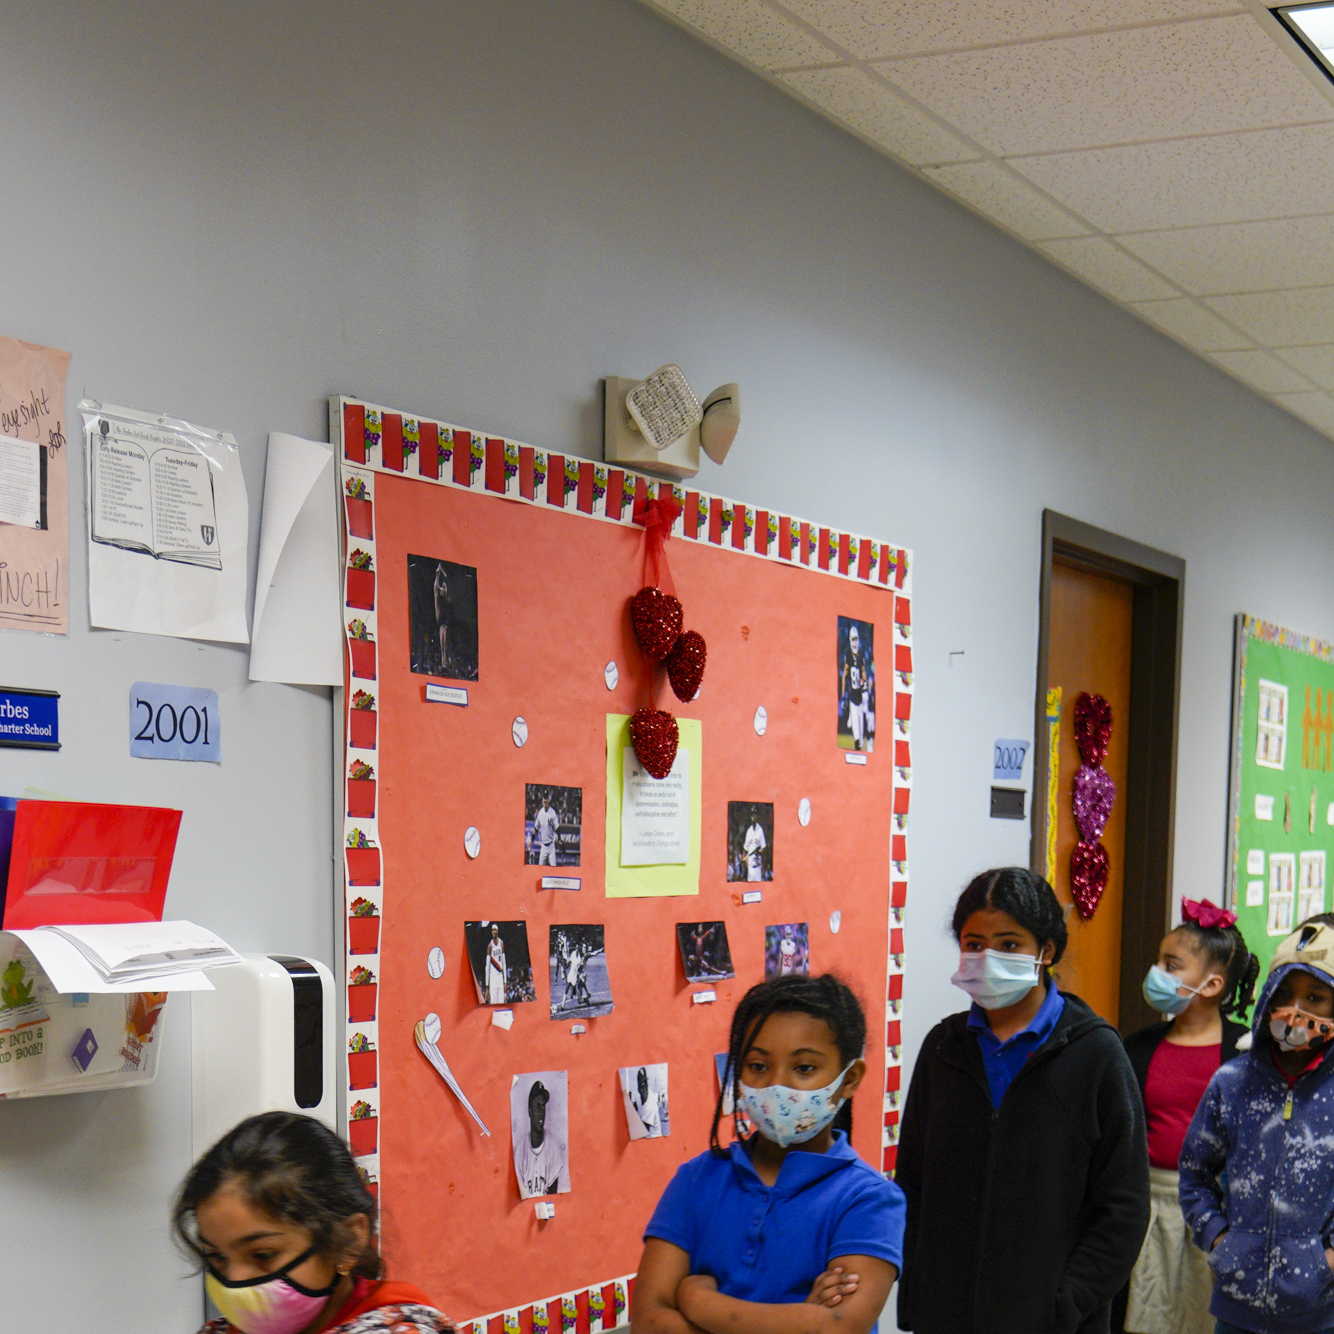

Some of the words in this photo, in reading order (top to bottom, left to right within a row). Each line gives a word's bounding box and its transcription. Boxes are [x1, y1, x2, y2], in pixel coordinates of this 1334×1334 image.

[2, 388, 50, 438] eyesight
[111, 447, 127, 456] Release
[129, 451, 144, 461] Monday
[25, 723, 52, 737] School
[134, 698, 210, 745] 2001
[995, 746, 1026, 770] 2002
[10, 1030, 33, 1047] INTO
[37, 1027, 43, 1039] a
[16, 1042, 43, 1060] BOOK!
